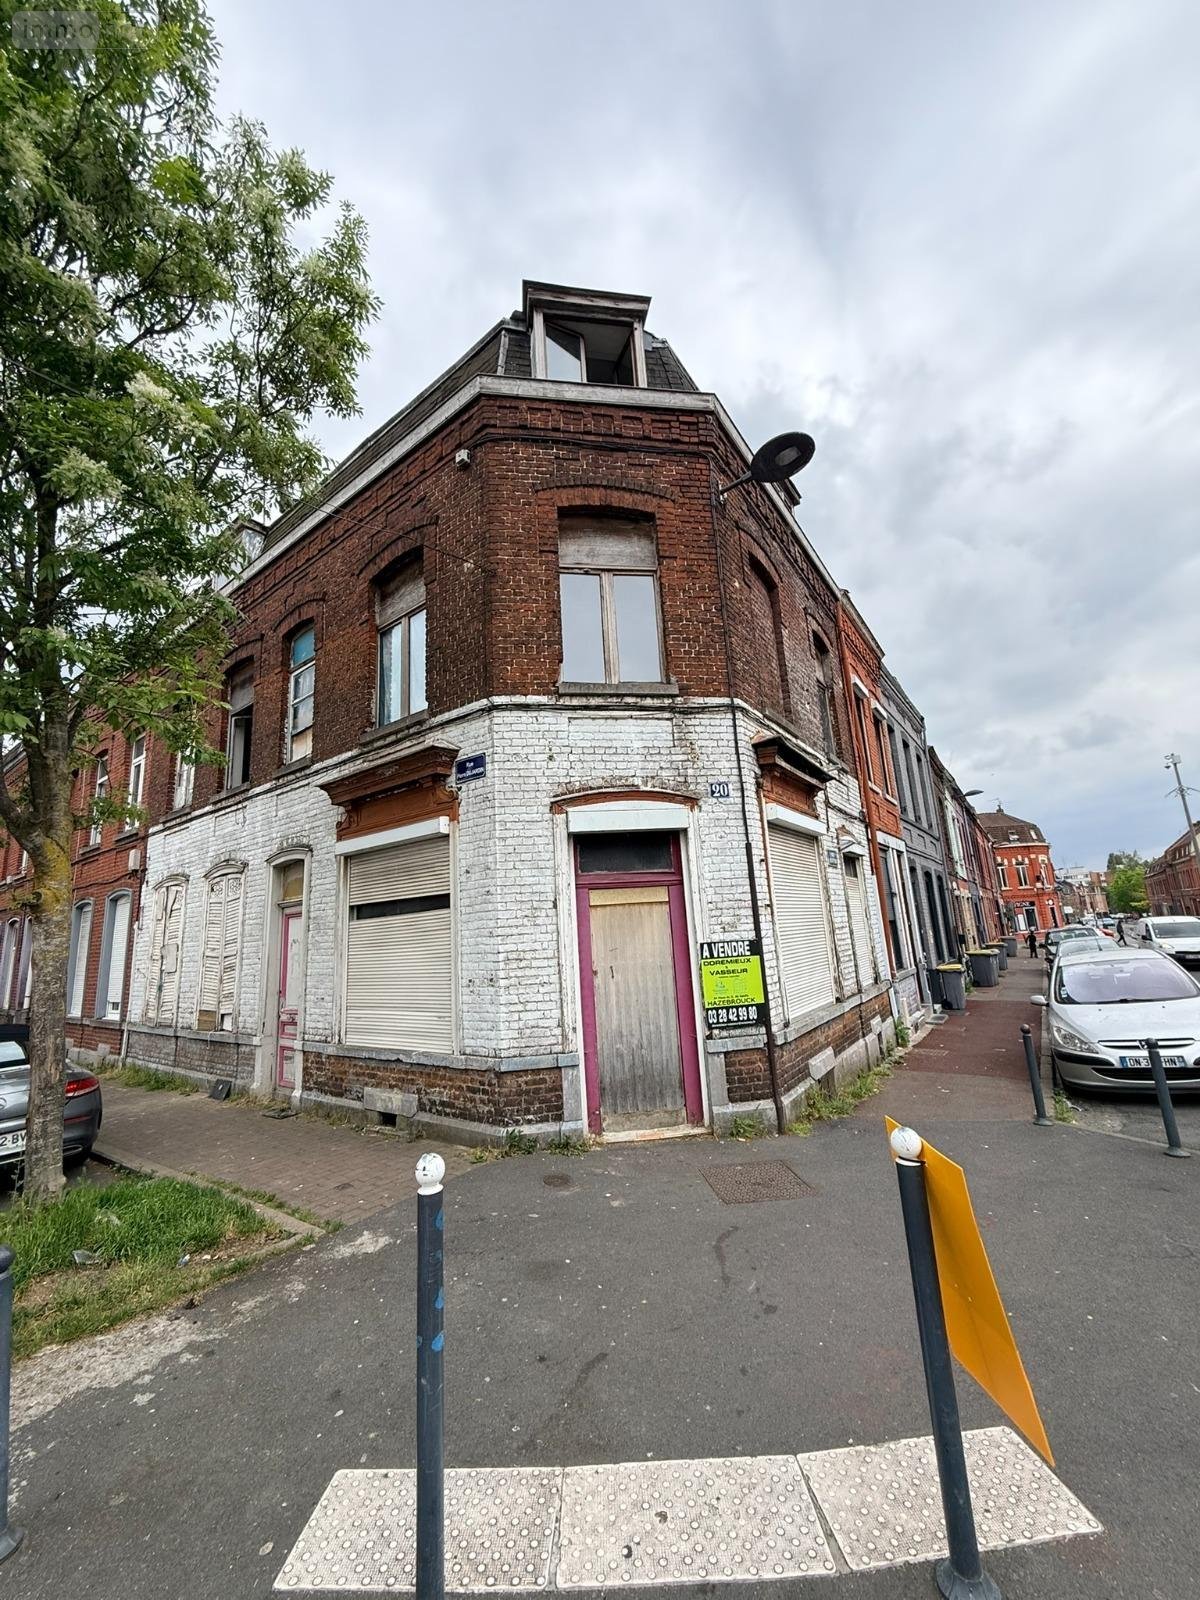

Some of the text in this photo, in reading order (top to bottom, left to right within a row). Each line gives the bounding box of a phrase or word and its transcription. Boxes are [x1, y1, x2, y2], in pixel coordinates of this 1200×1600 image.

[712, 784, 728, 796] 20
[703, 941, 750, 958] A VENDRE
[709, 968, 748, 976] VASSEUR
[707, 997, 756, 1006] HAZEBROUCK
[708, 1009, 717, 1023] 03
[728, 1008, 738, 1021] 42
